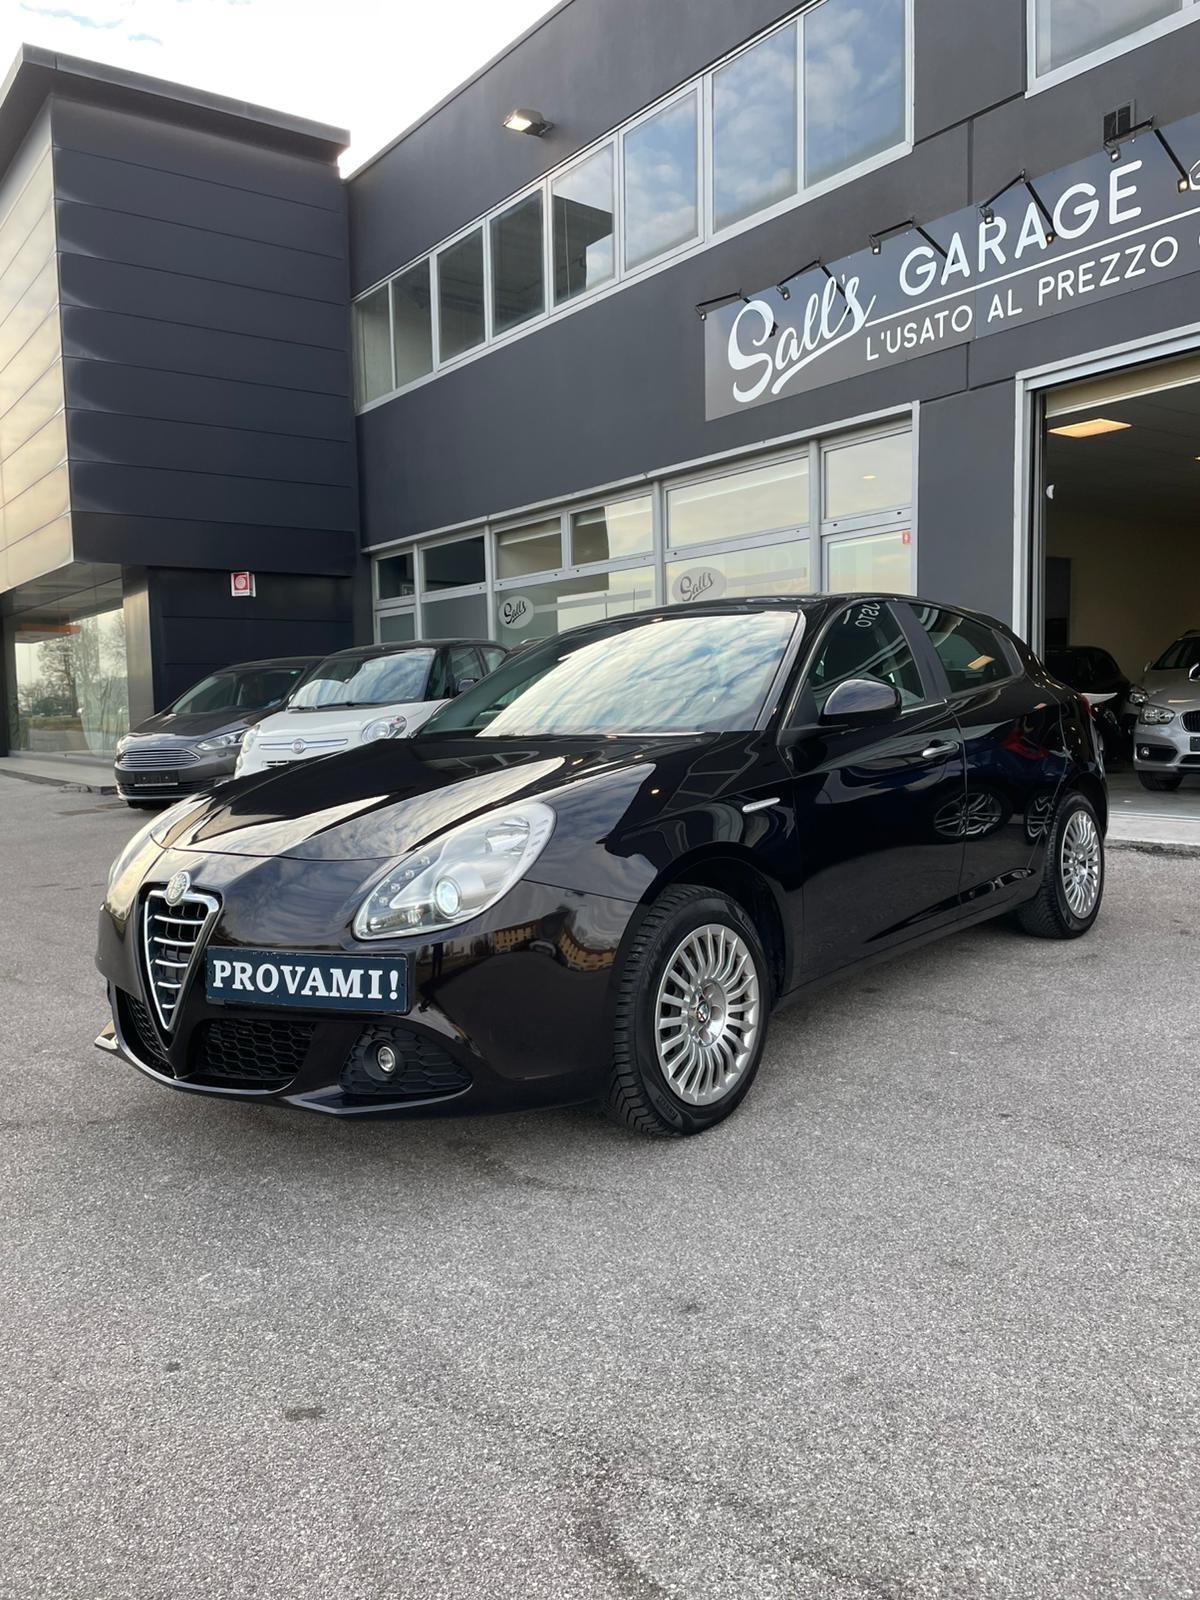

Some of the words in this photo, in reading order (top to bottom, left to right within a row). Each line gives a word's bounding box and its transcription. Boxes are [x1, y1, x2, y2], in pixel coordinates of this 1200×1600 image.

[727, 274, 877, 402] Sall's
[899, 160, 1143, 296] GARAGE
[866, 304, 973, 361] L'USATO
[987, 293, 1024, 324] AL
[1038, 235, 1179, 306] PREZZO
[212, 960, 399, 1000] PROVAMI!
